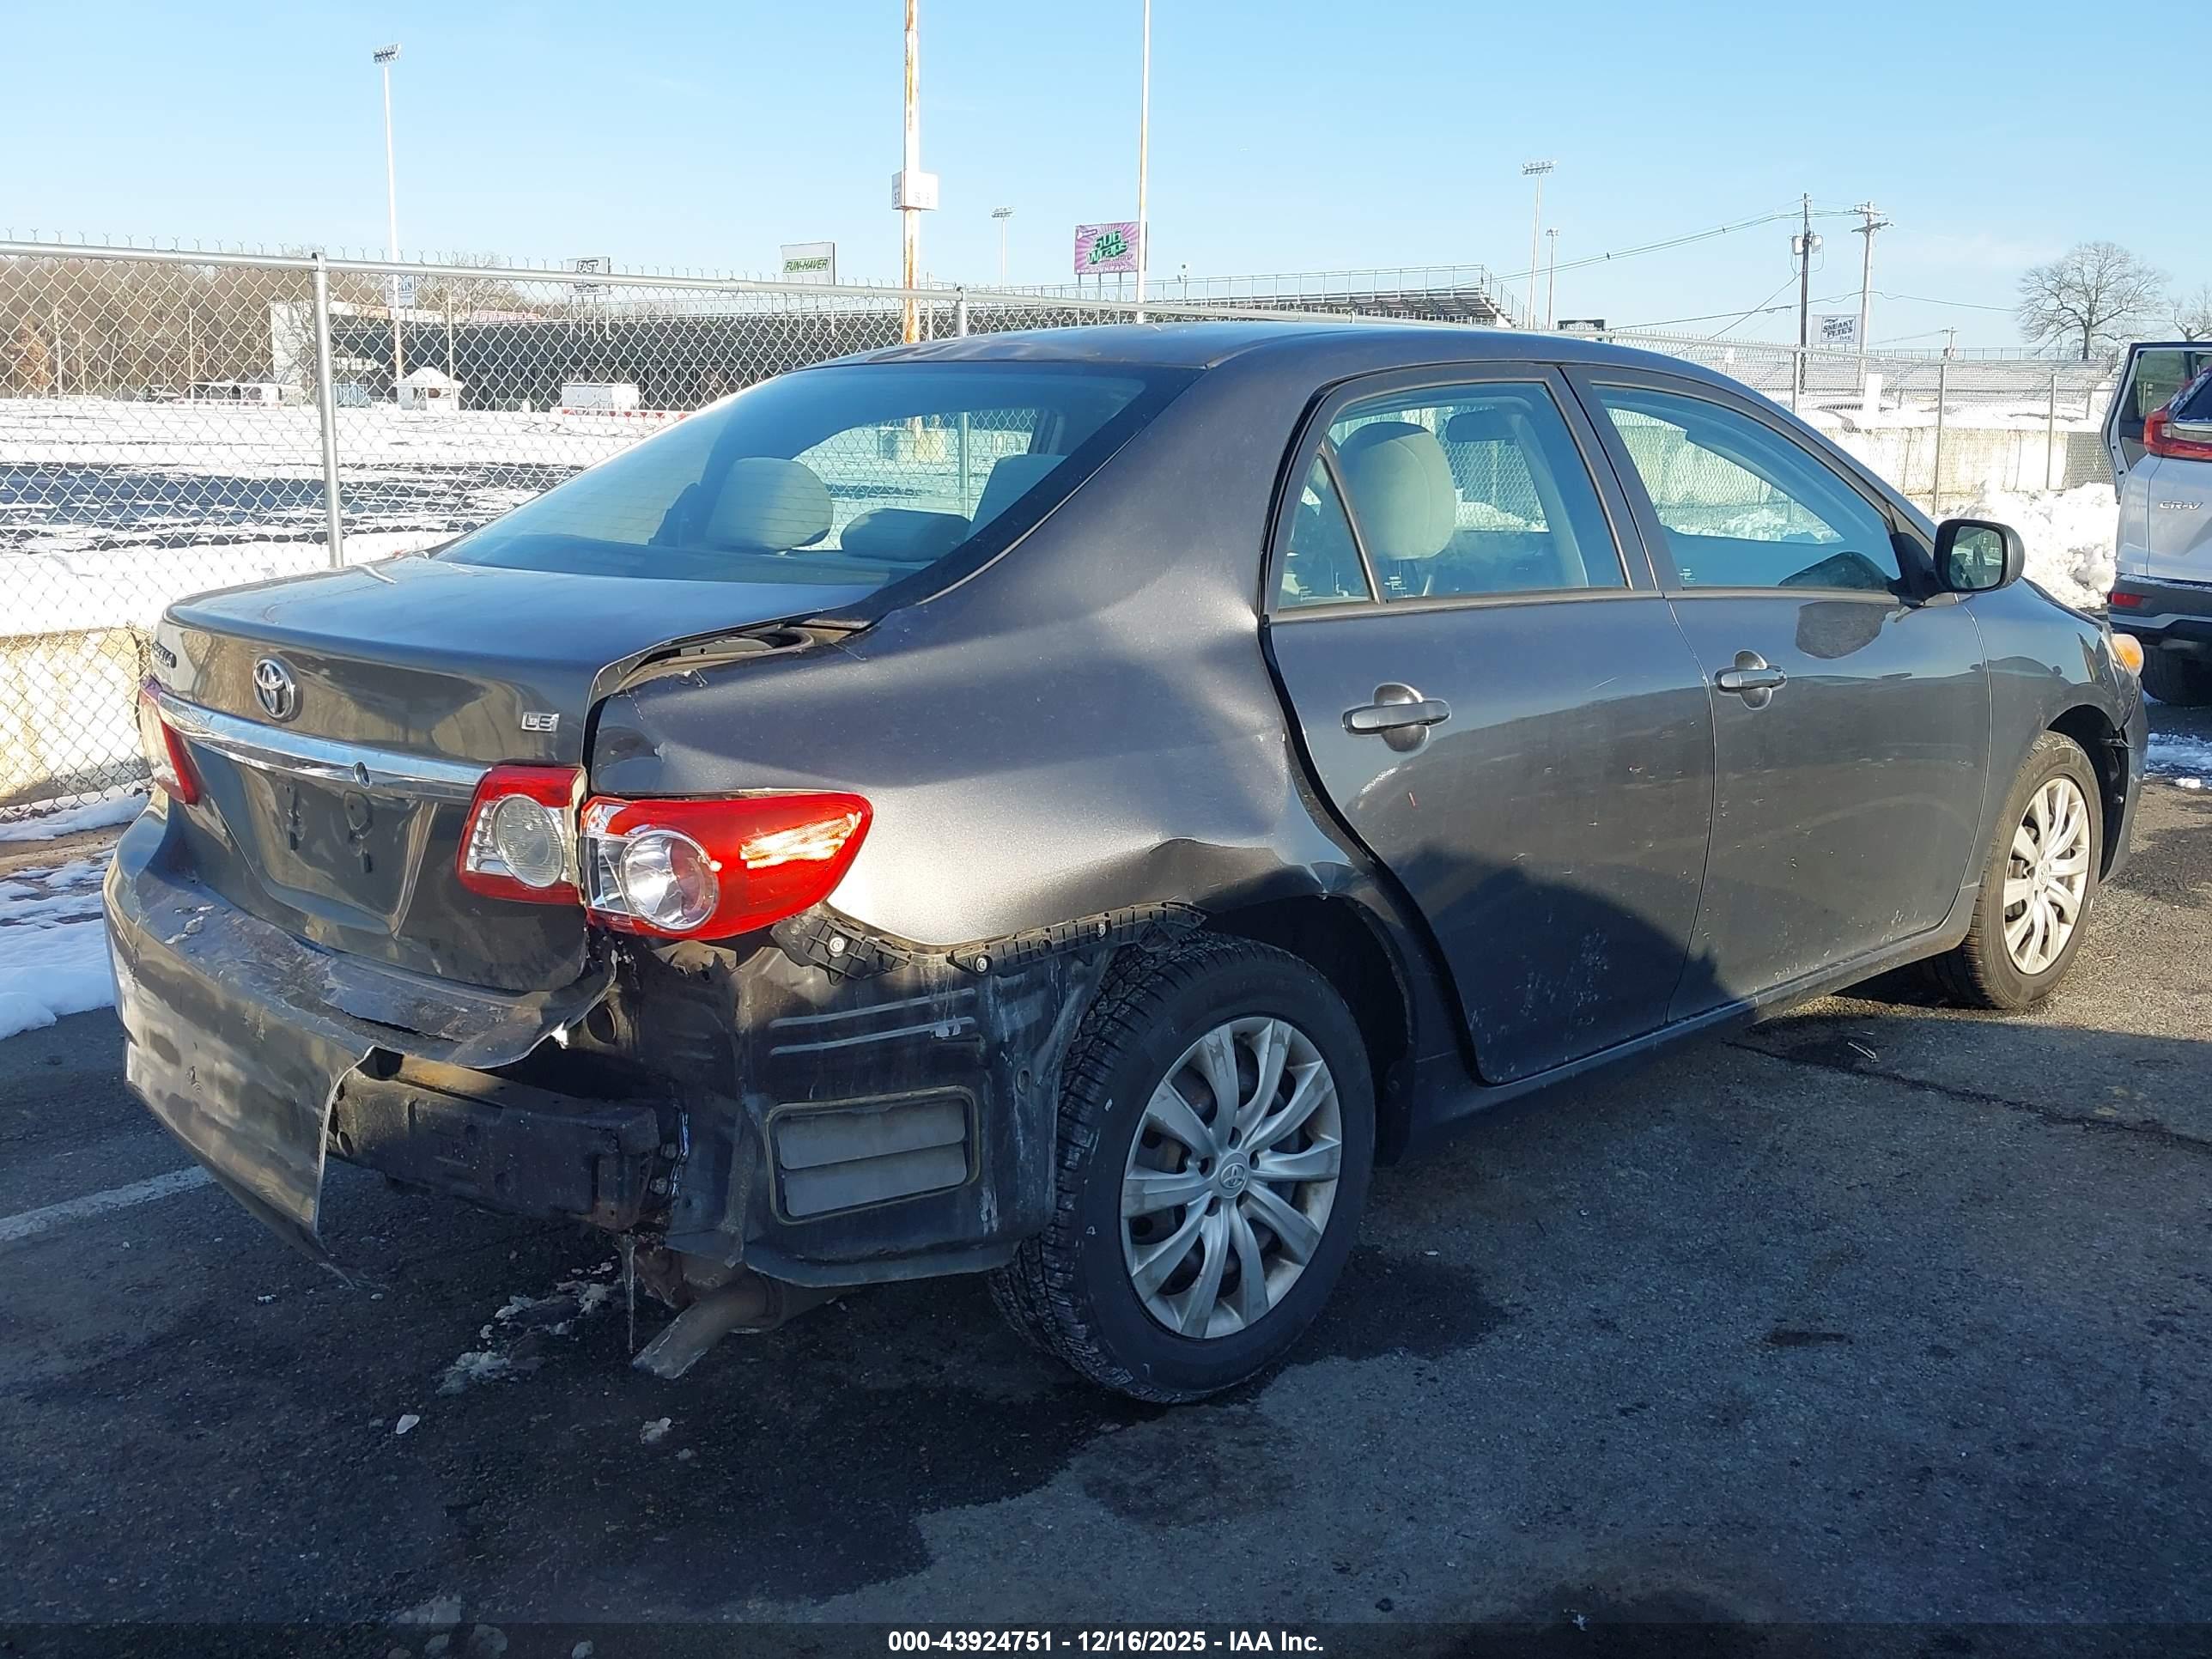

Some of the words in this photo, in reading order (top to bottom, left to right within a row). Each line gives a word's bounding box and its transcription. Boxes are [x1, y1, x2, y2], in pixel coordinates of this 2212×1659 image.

[785, 258, 829, 271] FUN-HAVER
[1822, 319, 1855, 334] SNEAKY
[2159, 501, 2204, 510] CR-V
[521, 712, 560, 732] LE
